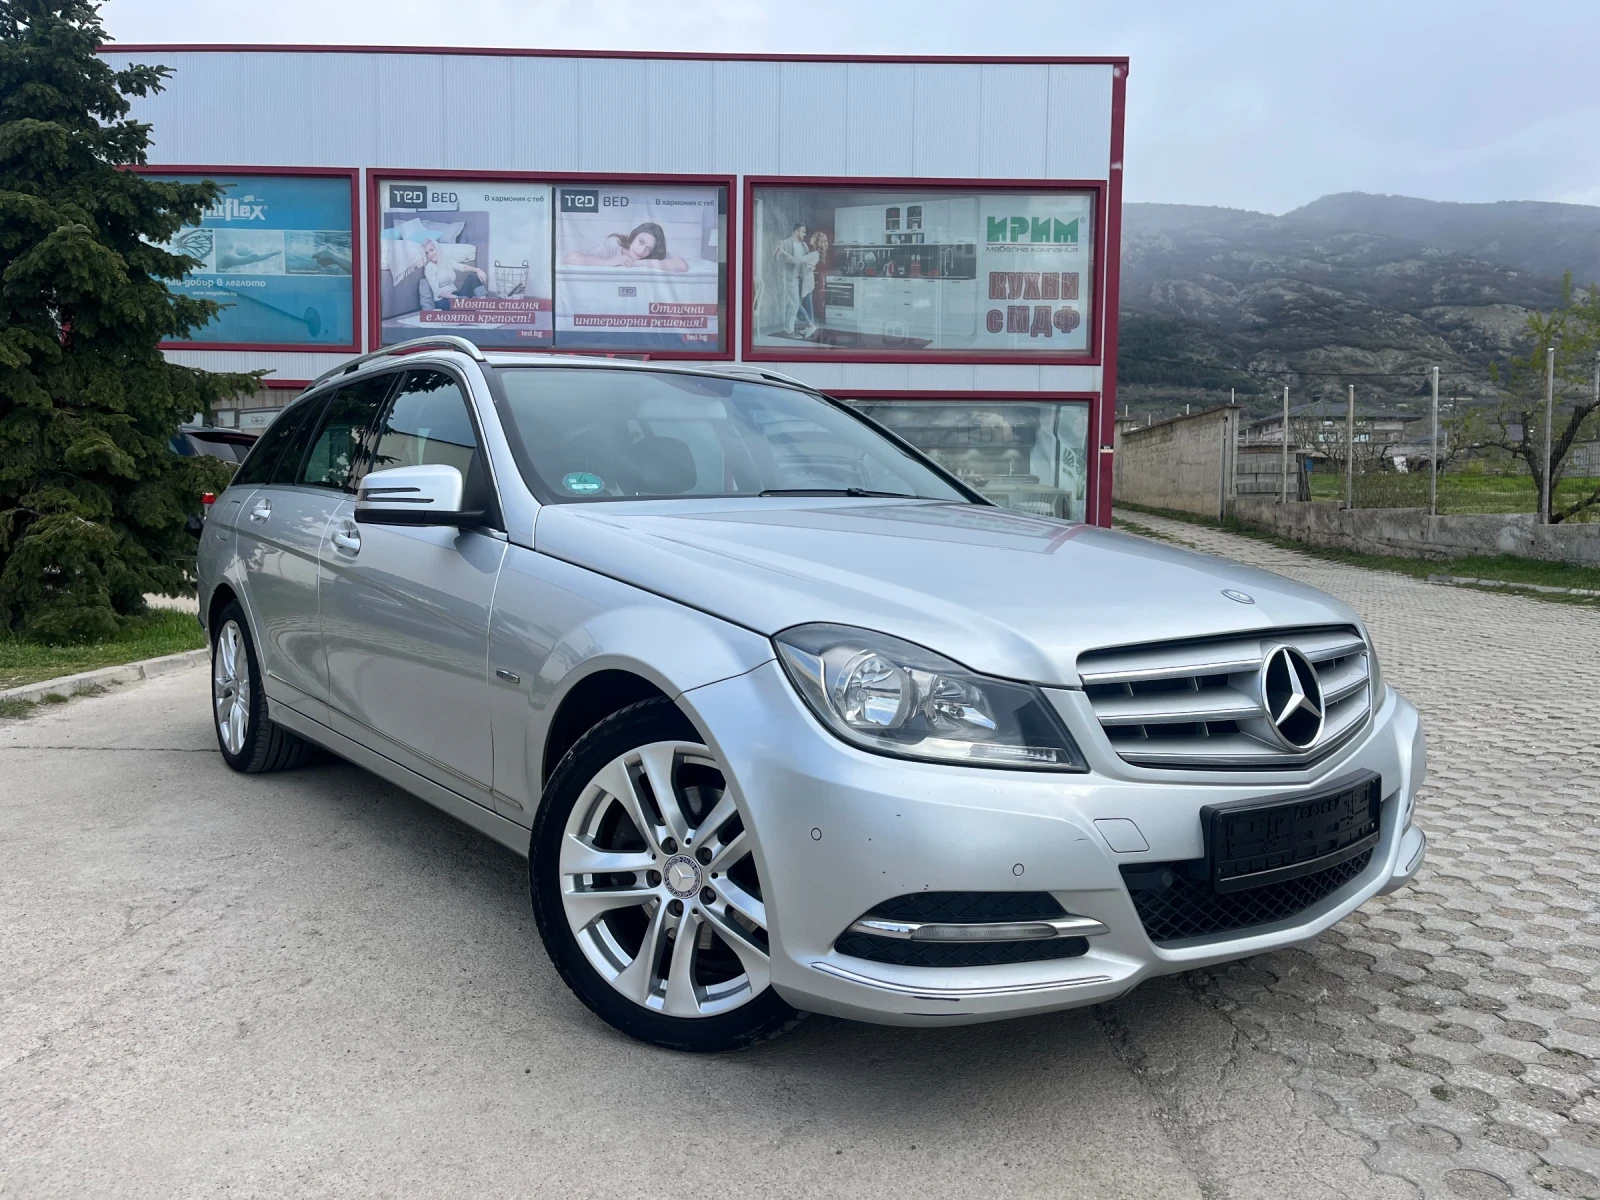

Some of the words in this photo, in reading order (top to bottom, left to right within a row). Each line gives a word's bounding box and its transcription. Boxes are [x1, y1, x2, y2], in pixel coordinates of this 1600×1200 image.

[431, 192, 458, 203] BED
[532, 195, 545, 203] теб
[603, 196, 629, 207] BED
[703, 199, 715, 207] теб
[986, 216, 1079, 243] ИРИМ
[988, 271, 1080, 300] КУХНИ
[453, 298, 496, 309] Моята
[498, 300, 540, 310] спалня
[651, 302, 705, 314] Отлични
[426, 313, 432, 321] е
[435, 313, 475, 322] моята
[478, 313, 532, 324] крепост!
[575, 316, 648, 327] интериорни
[650, 316, 705, 328] решения!
[1006, 305, 1081, 337] МДФ
[521, 330, 543, 338] ted.bg
[686, 333, 708, 342] ted.bg
